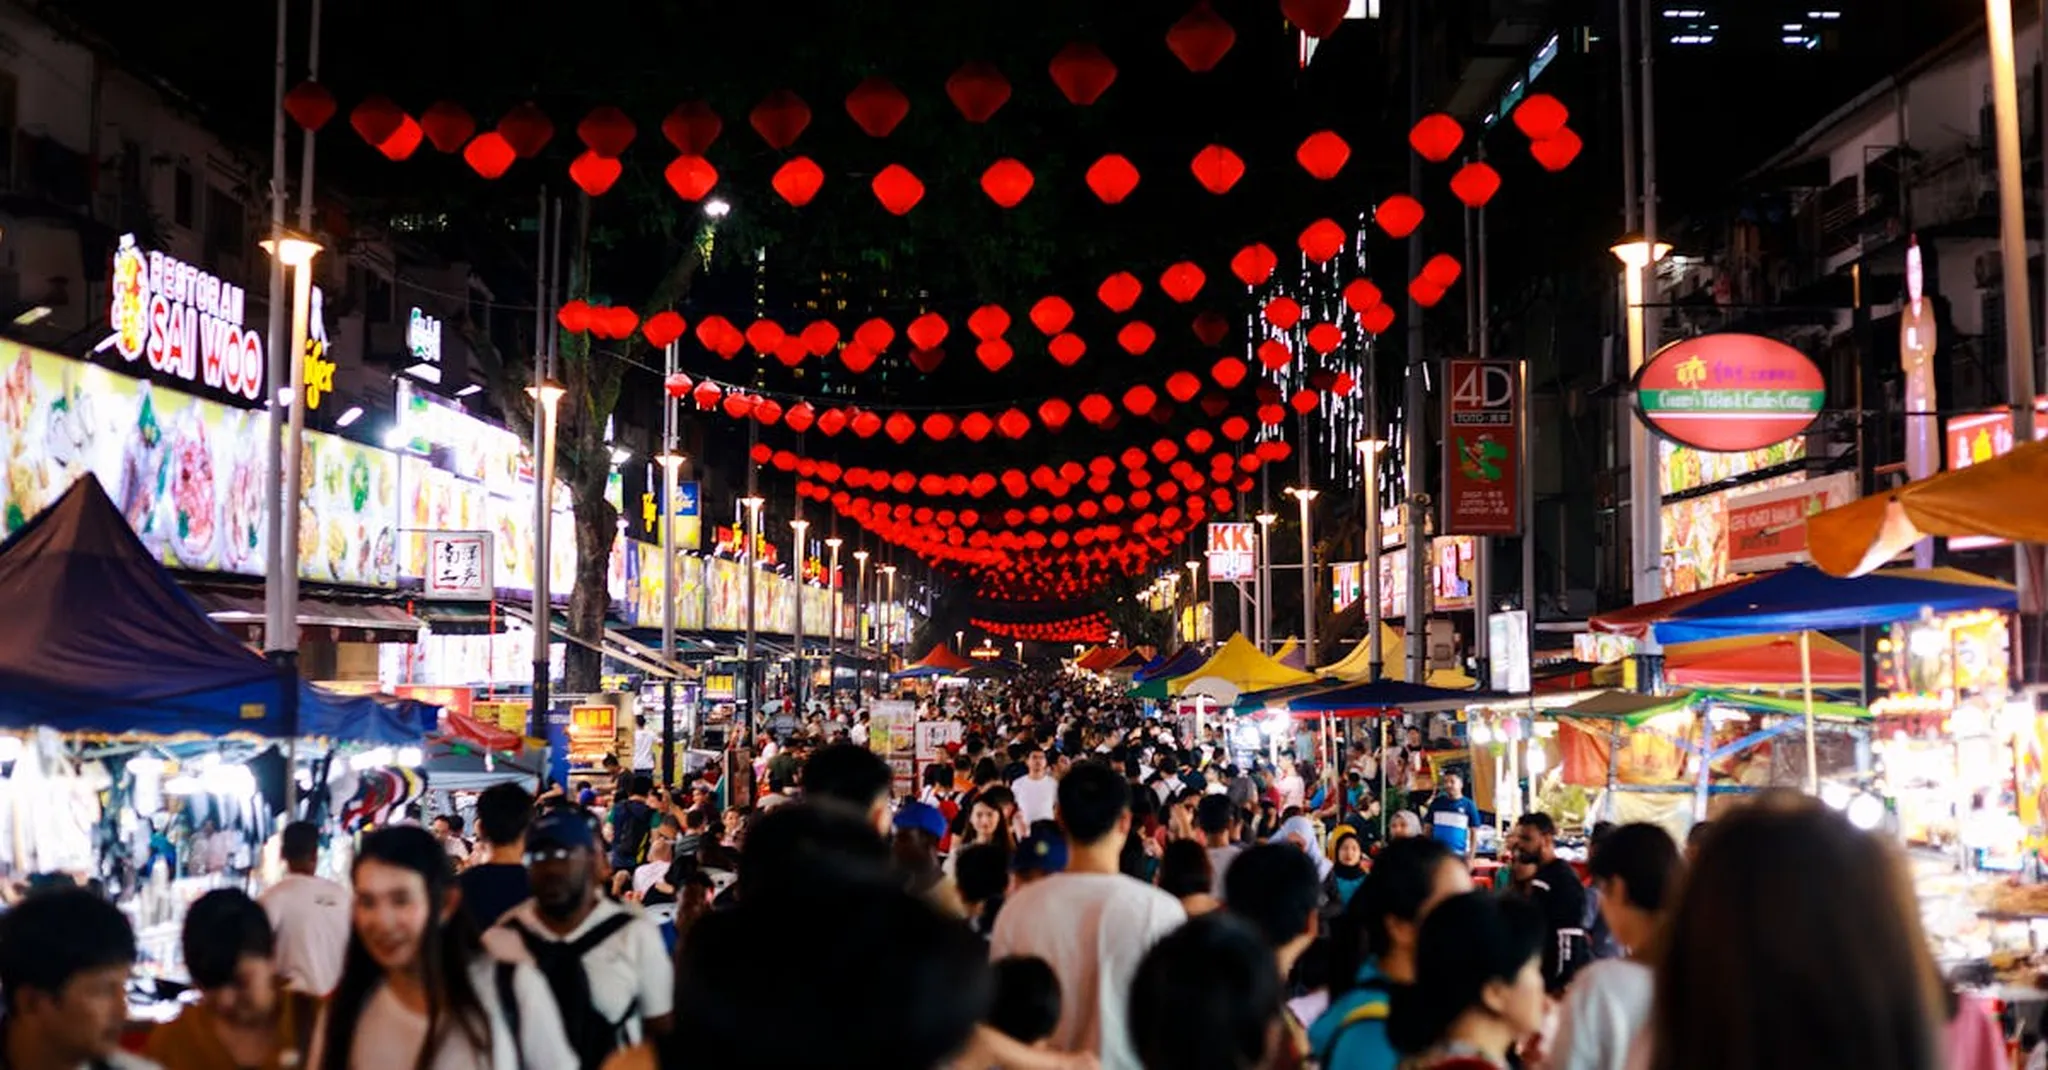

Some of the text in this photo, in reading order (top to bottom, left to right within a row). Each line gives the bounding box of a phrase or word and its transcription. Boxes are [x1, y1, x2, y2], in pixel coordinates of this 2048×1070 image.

[150, 251, 244, 325] RESTORAN
[147, 295, 263, 400] SAI WOO
[303, 339, 336, 410] iger
[1454, 365, 1512, 407] 4D
[1213, 525, 1249, 551] KK
